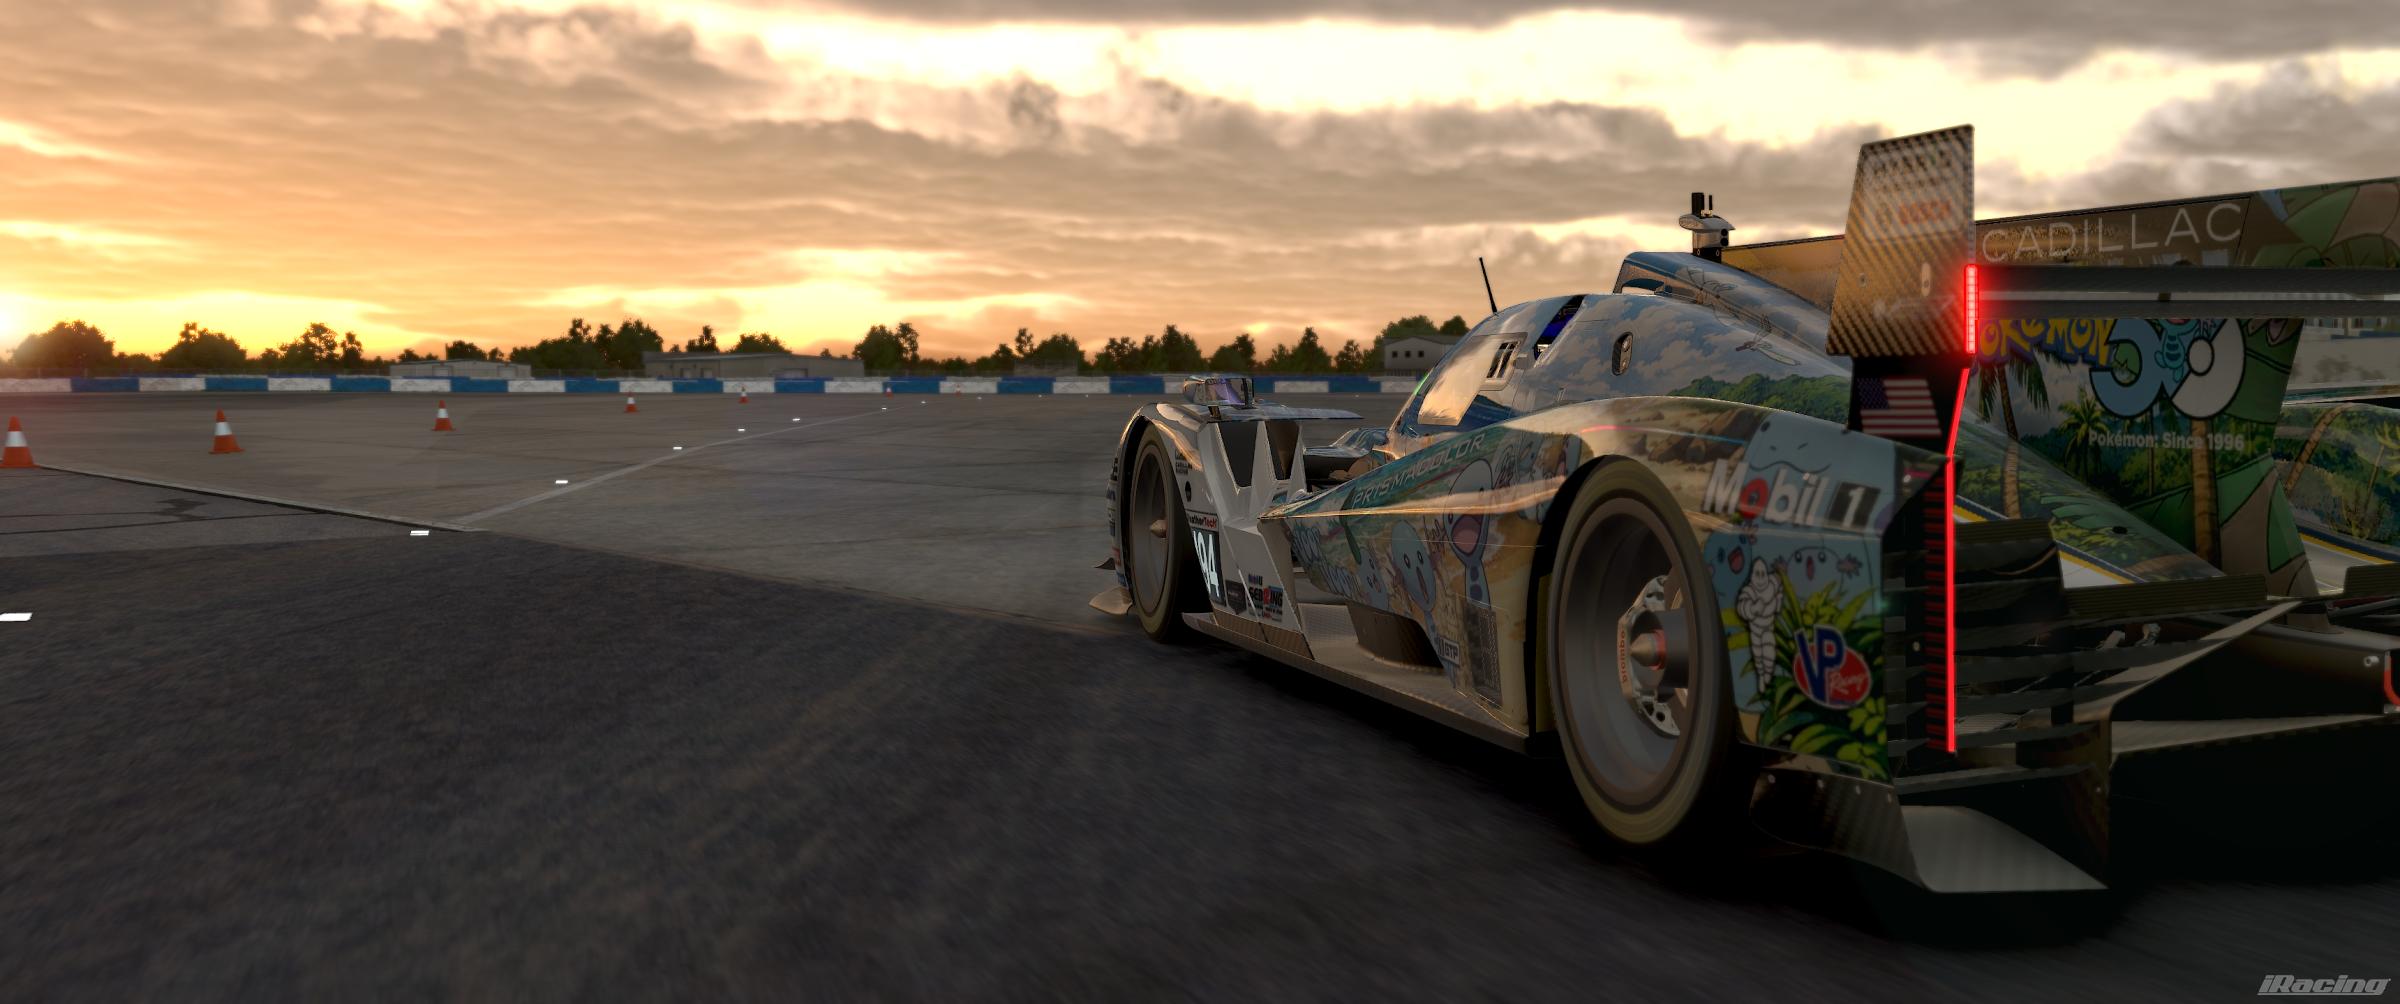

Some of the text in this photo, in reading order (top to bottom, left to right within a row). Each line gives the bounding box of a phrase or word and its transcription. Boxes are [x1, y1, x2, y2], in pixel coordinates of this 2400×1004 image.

[1982, 203, 2241, 263] CADILLAC
[1352, 433, 1486, 510] PRISMACOLOR
[2088, 430, 2245, 451] Pokémon: Since 1996
[1702, 459, 1871, 528] Mobil 1
[1445, 643, 1458, 660] GTP
[1794, 624, 1846, 704] VP
